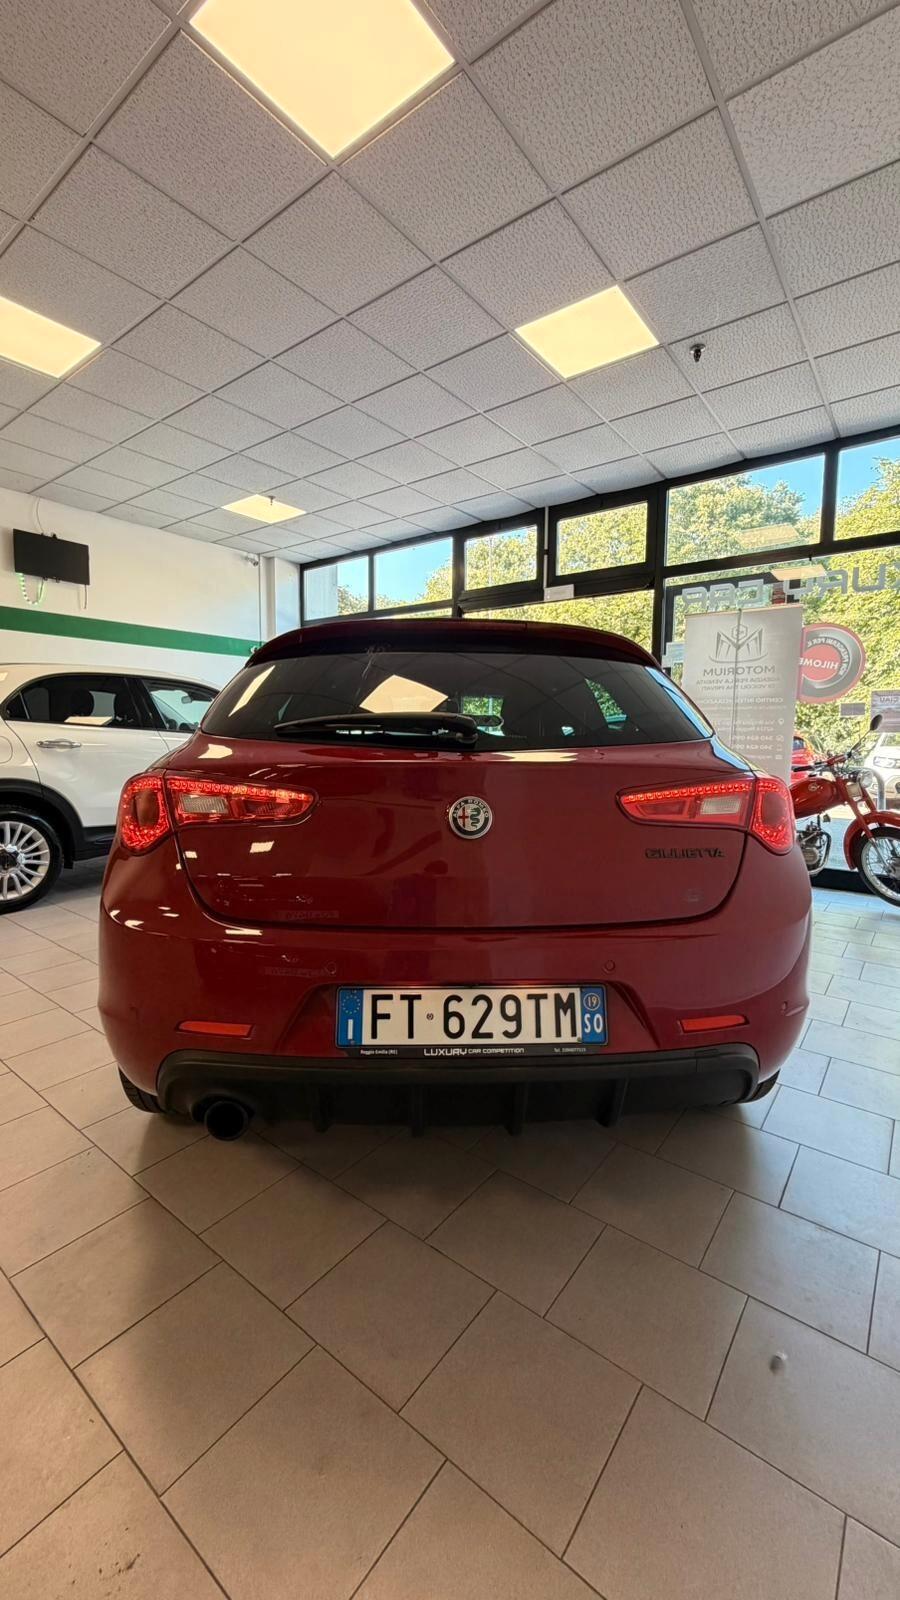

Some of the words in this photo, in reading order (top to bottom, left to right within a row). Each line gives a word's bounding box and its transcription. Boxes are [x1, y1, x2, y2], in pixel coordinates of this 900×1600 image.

[644, 847, 726, 859] GIULIETTA
[586, 996, 598, 1008] 19
[371, 994, 423, 1039] FT
[443, 992, 577, 1039] 629TM
[584, 1013, 603, 1033] SO
[347, 1019, 354, 1040] I
[424, 1048, 467, 1056] LUXURY
